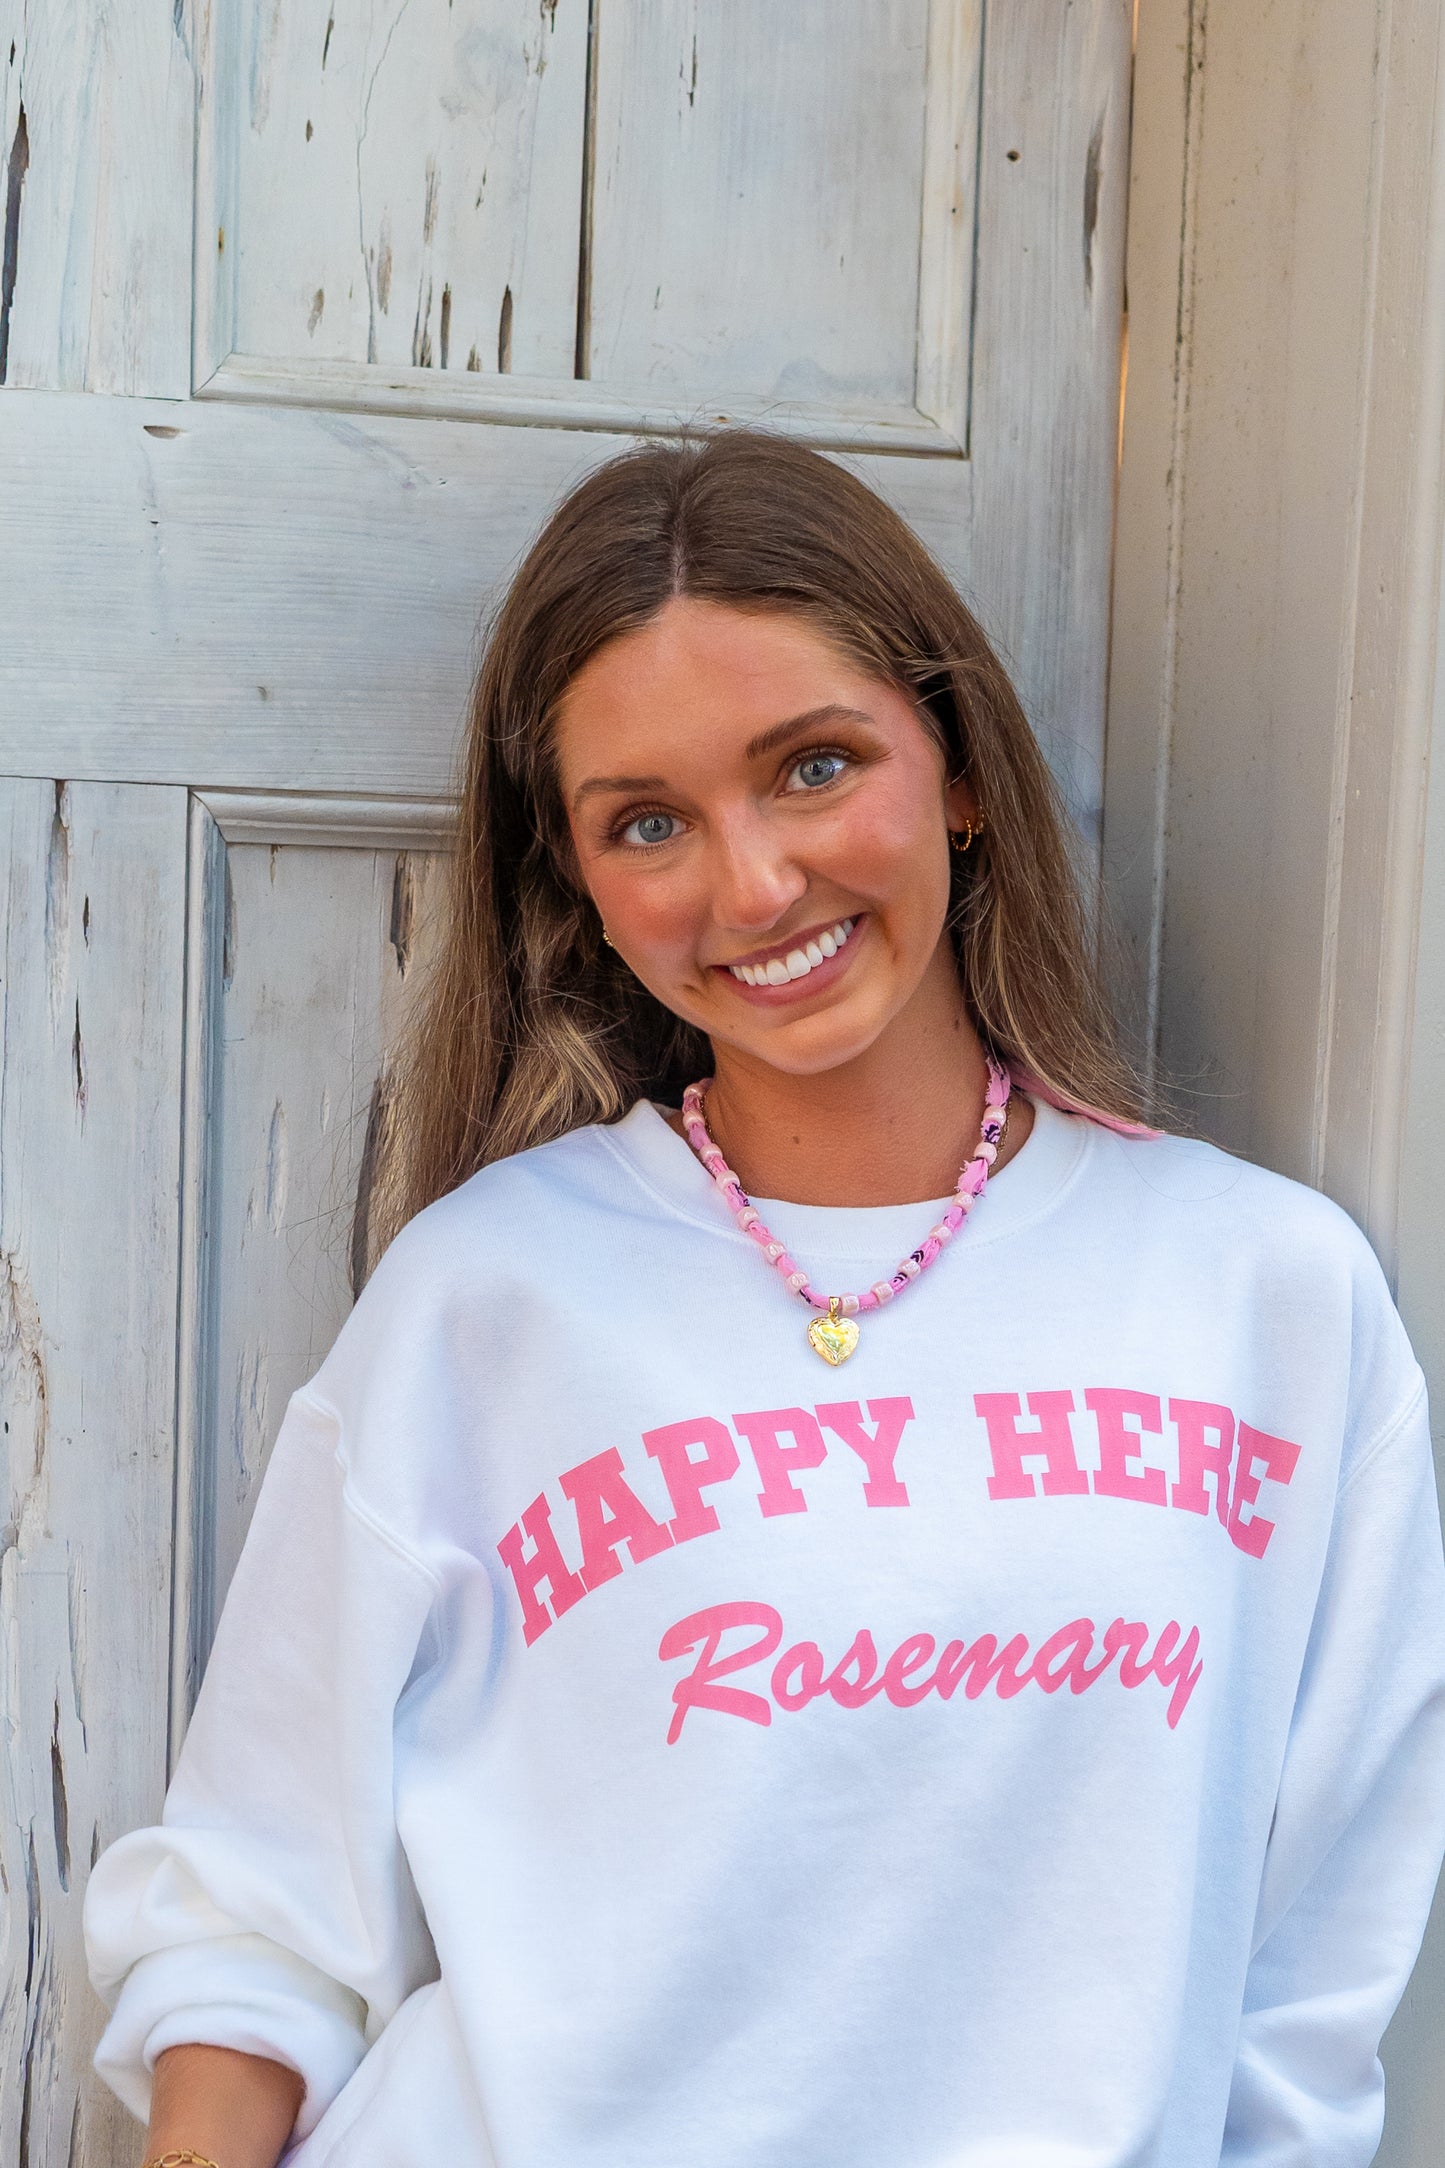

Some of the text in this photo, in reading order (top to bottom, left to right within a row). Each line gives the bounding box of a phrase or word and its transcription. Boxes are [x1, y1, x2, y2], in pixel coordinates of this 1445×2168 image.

[496, 1387, 1302, 1647] HAPPY HERE
[658, 1601, 1203, 1745] Rosemary
